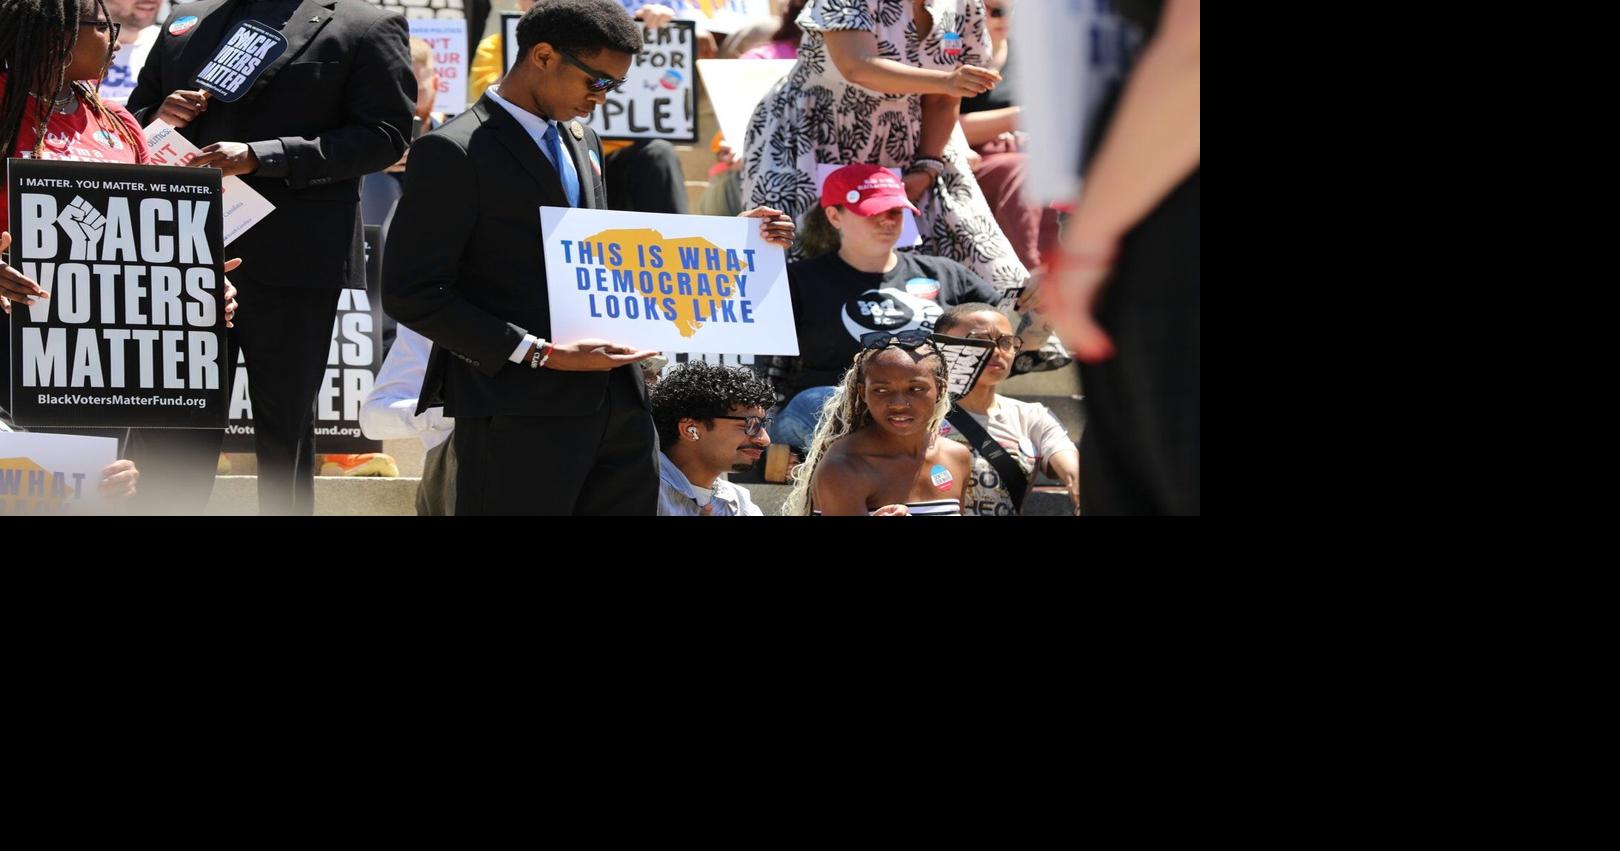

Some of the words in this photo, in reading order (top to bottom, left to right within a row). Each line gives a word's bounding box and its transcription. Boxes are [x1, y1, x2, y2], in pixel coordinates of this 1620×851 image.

[226, 26, 278, 60] BACK
[213, 44, 262, 76] VOTERS
[635, 51, 685, 68] FOR
[197, 61, 247, 93] MATTER
[586, 88, 695, 133] PLE!
[20, 178, 23, 186] I
[26, 178, 73, 188] MATTER.
[76, 180, 99, 190] YOU
[102, 181, 147, 191] MATTER.
[150, 183, 167, 192] WE
[169, 185, 212, 194] MATTER.
[21, 193, 214, 265] BACK
[560, 240, 623, 266] THIS
[638, 244, 663, 269] IS
[678, 246, 755, 272] WHAT
[22, 262, 217, 327] VOTERS
[575, 267, 747, 298] DEMOCRACY
[589, 294, 677, 321] LOOKS
[693, 299, 754, 323] LIKE
[22, 327, 219, 390] MATTER
[38, 394, 206, 408] BlackVotersMatterFund.org
